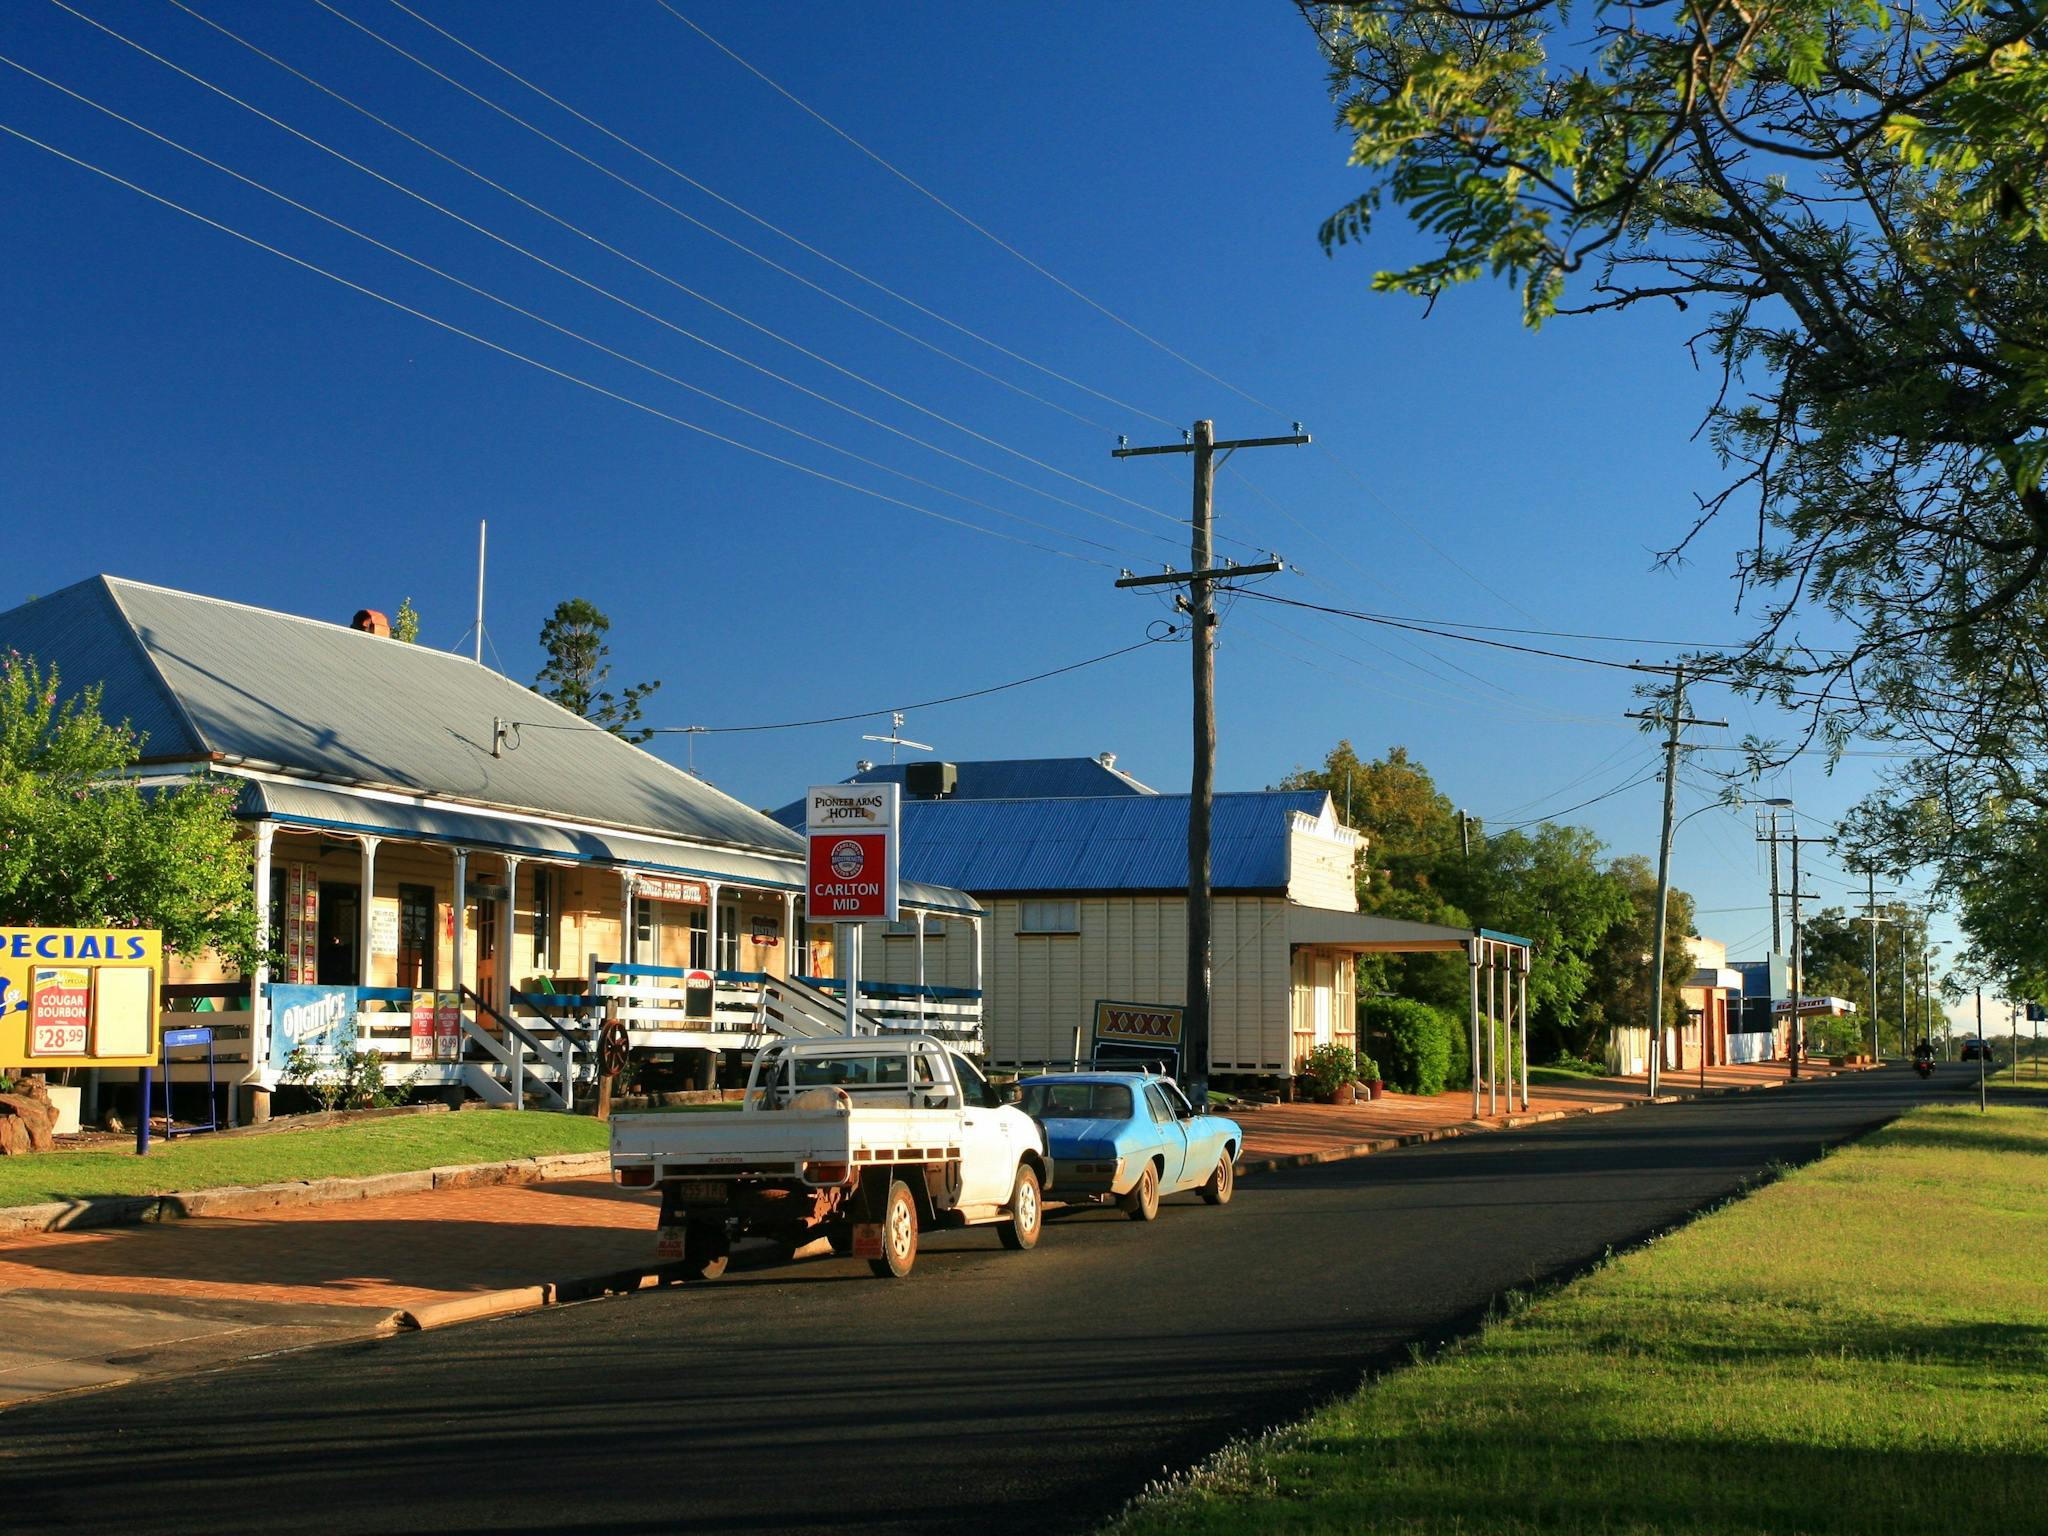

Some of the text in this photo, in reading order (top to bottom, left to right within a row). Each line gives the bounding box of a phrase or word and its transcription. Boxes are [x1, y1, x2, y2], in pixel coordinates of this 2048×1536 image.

[815, 796, 882, 808] PIONEER ARMS
[829, 808, 867, 818] HOTEL
[815, 883, 879, 896] CARLTON
[833, 898, 860, 911] MID
[41, 995, 83, 1006] COUGAR
[37, 1007, 86, 1018] BOURBON
[1104, 1010, 1174, 1037] XXXX
[39, 1028, 83, 1047] $28.99
